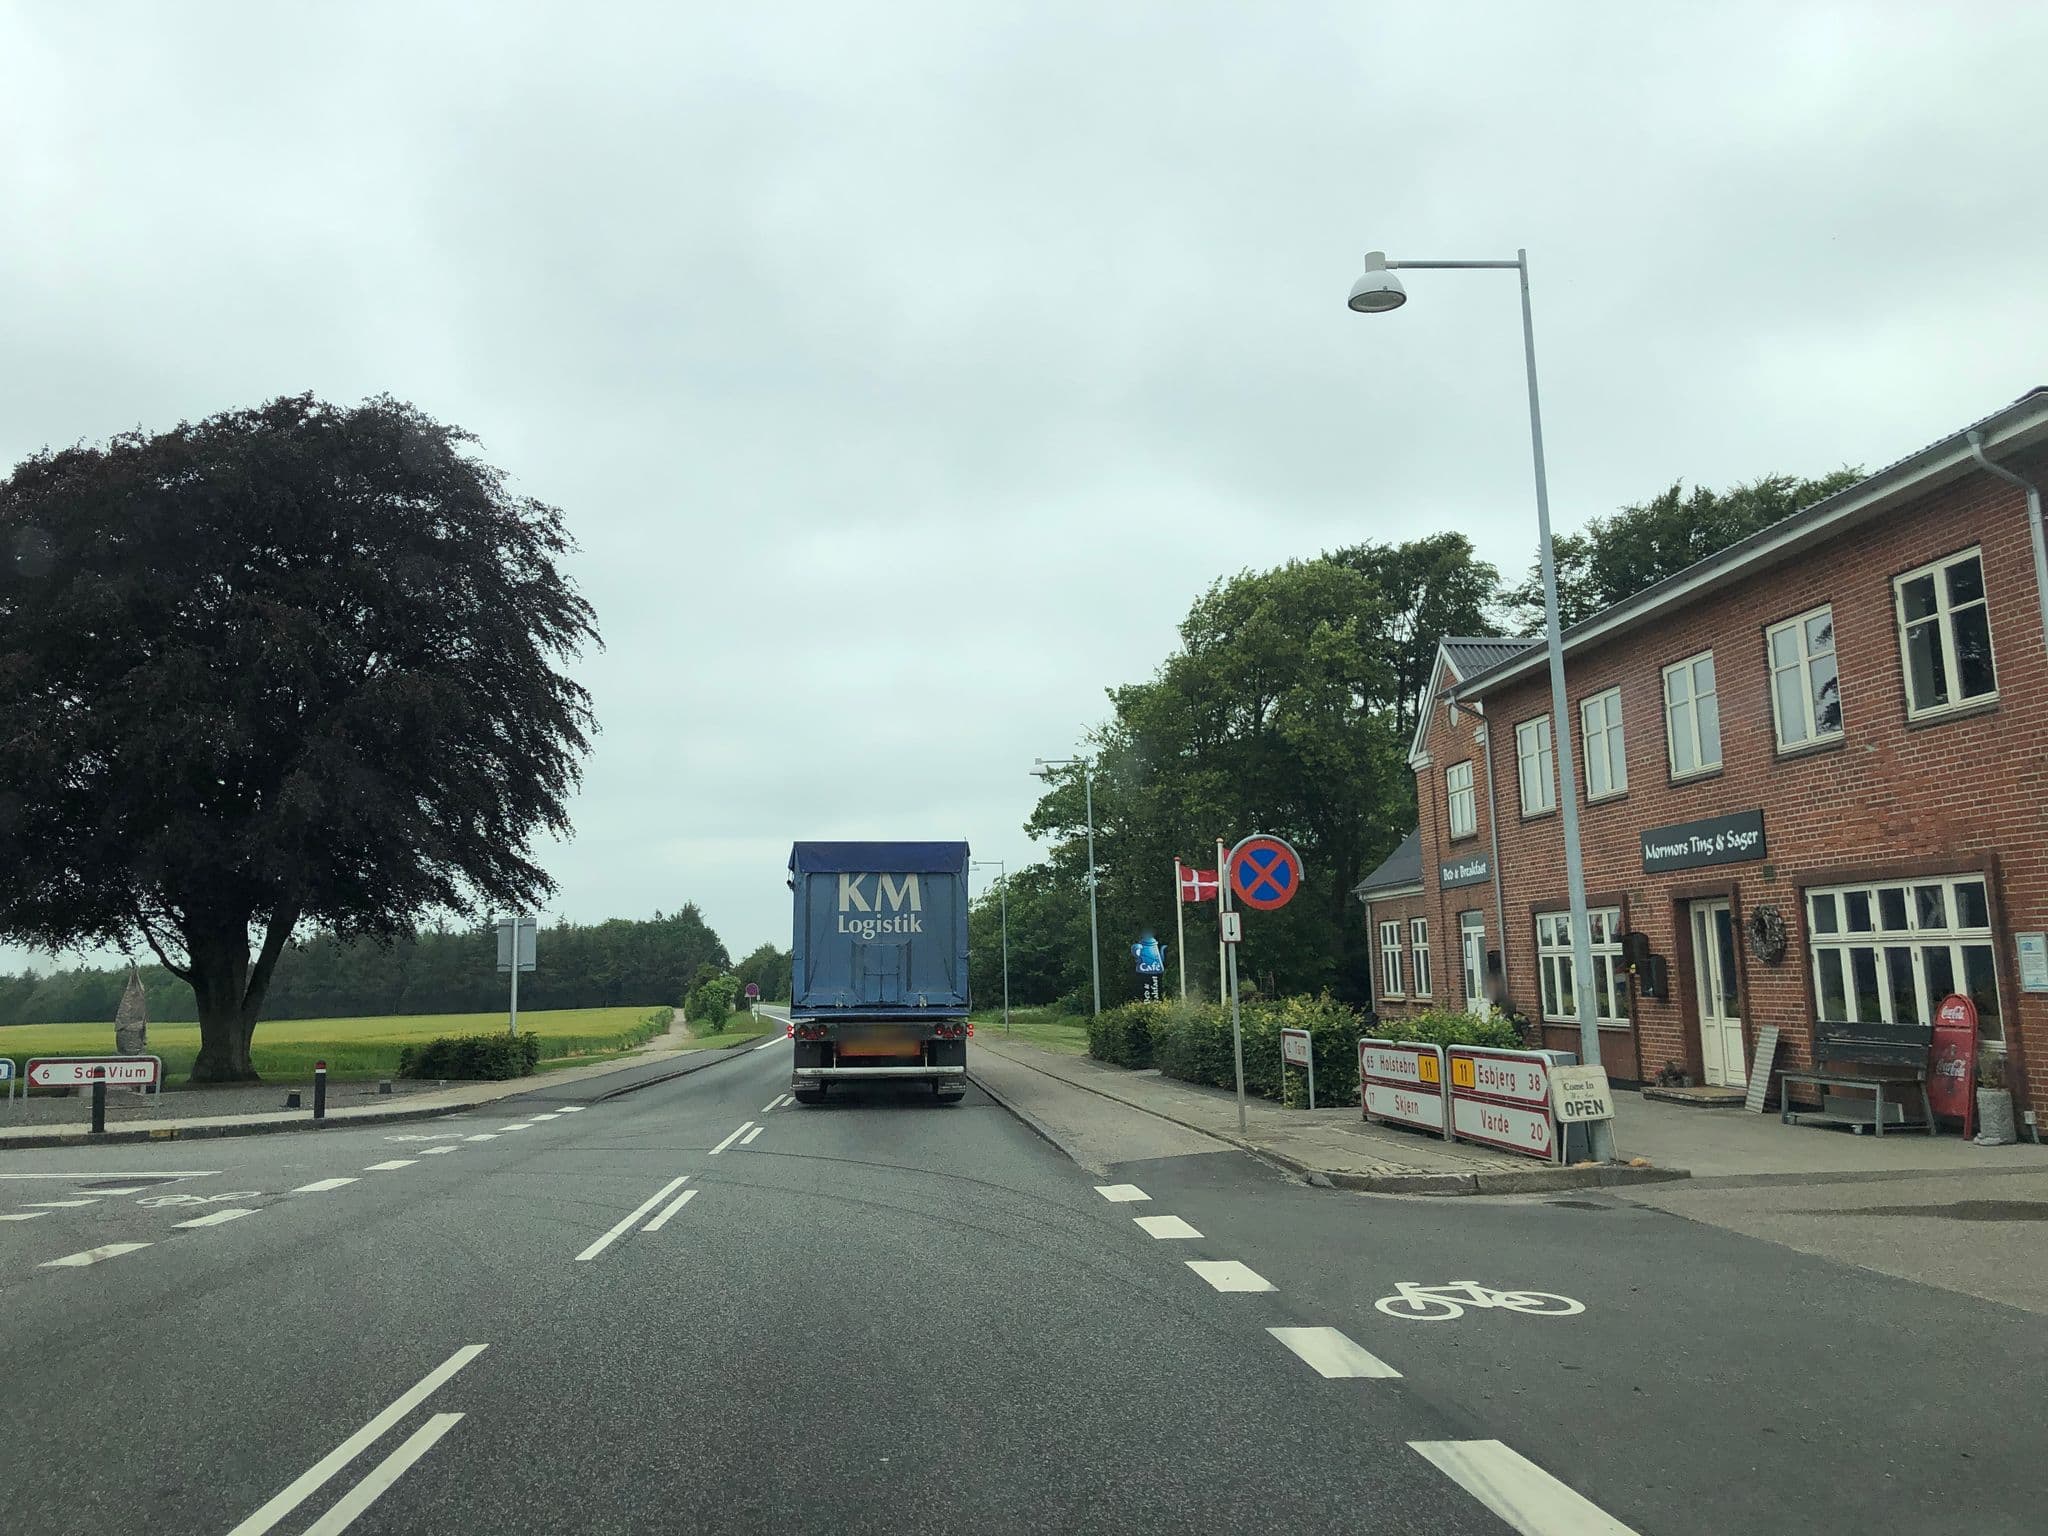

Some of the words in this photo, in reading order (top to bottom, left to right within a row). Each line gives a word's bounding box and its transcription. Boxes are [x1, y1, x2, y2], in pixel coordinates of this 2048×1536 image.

[1645, 844, 1689, 860] Mormors
[1689, 836, 1714, 856] Ting
[1715, 834, 1725, 851] &
[1727, 830, 1759, 850] Sager
[838, 872, 922, 912] KM
[838, 914, 923, 940] Logistik
[42, 1069, 50, 1080] 6
[109, 1066, 147, 1078] Vium
[1367, 1055, 1374, 1069] 65
[1380, 1055, 1416, 1075] Holstebro
[1425, 1061, 1433, 1078] 11
[1459, 1064, 1468, 1082] 11
[1478, 1064, 1515, 1091] Esbjerg
[1528, 1073, 1541, 1091] 38
[1563, 1081, 1584, 1091] Come
[1585, 1080, 1594, 1090] In
[1369, 1092, 1375, 1105] 17
[1394, 1094, 1419, 1116] Skjern
[1564, 1099, 1605, 1117] OPEN
[1481, 1109, 1509, 1134] Varde
[1531, 1122, 1543, 1141] 20
